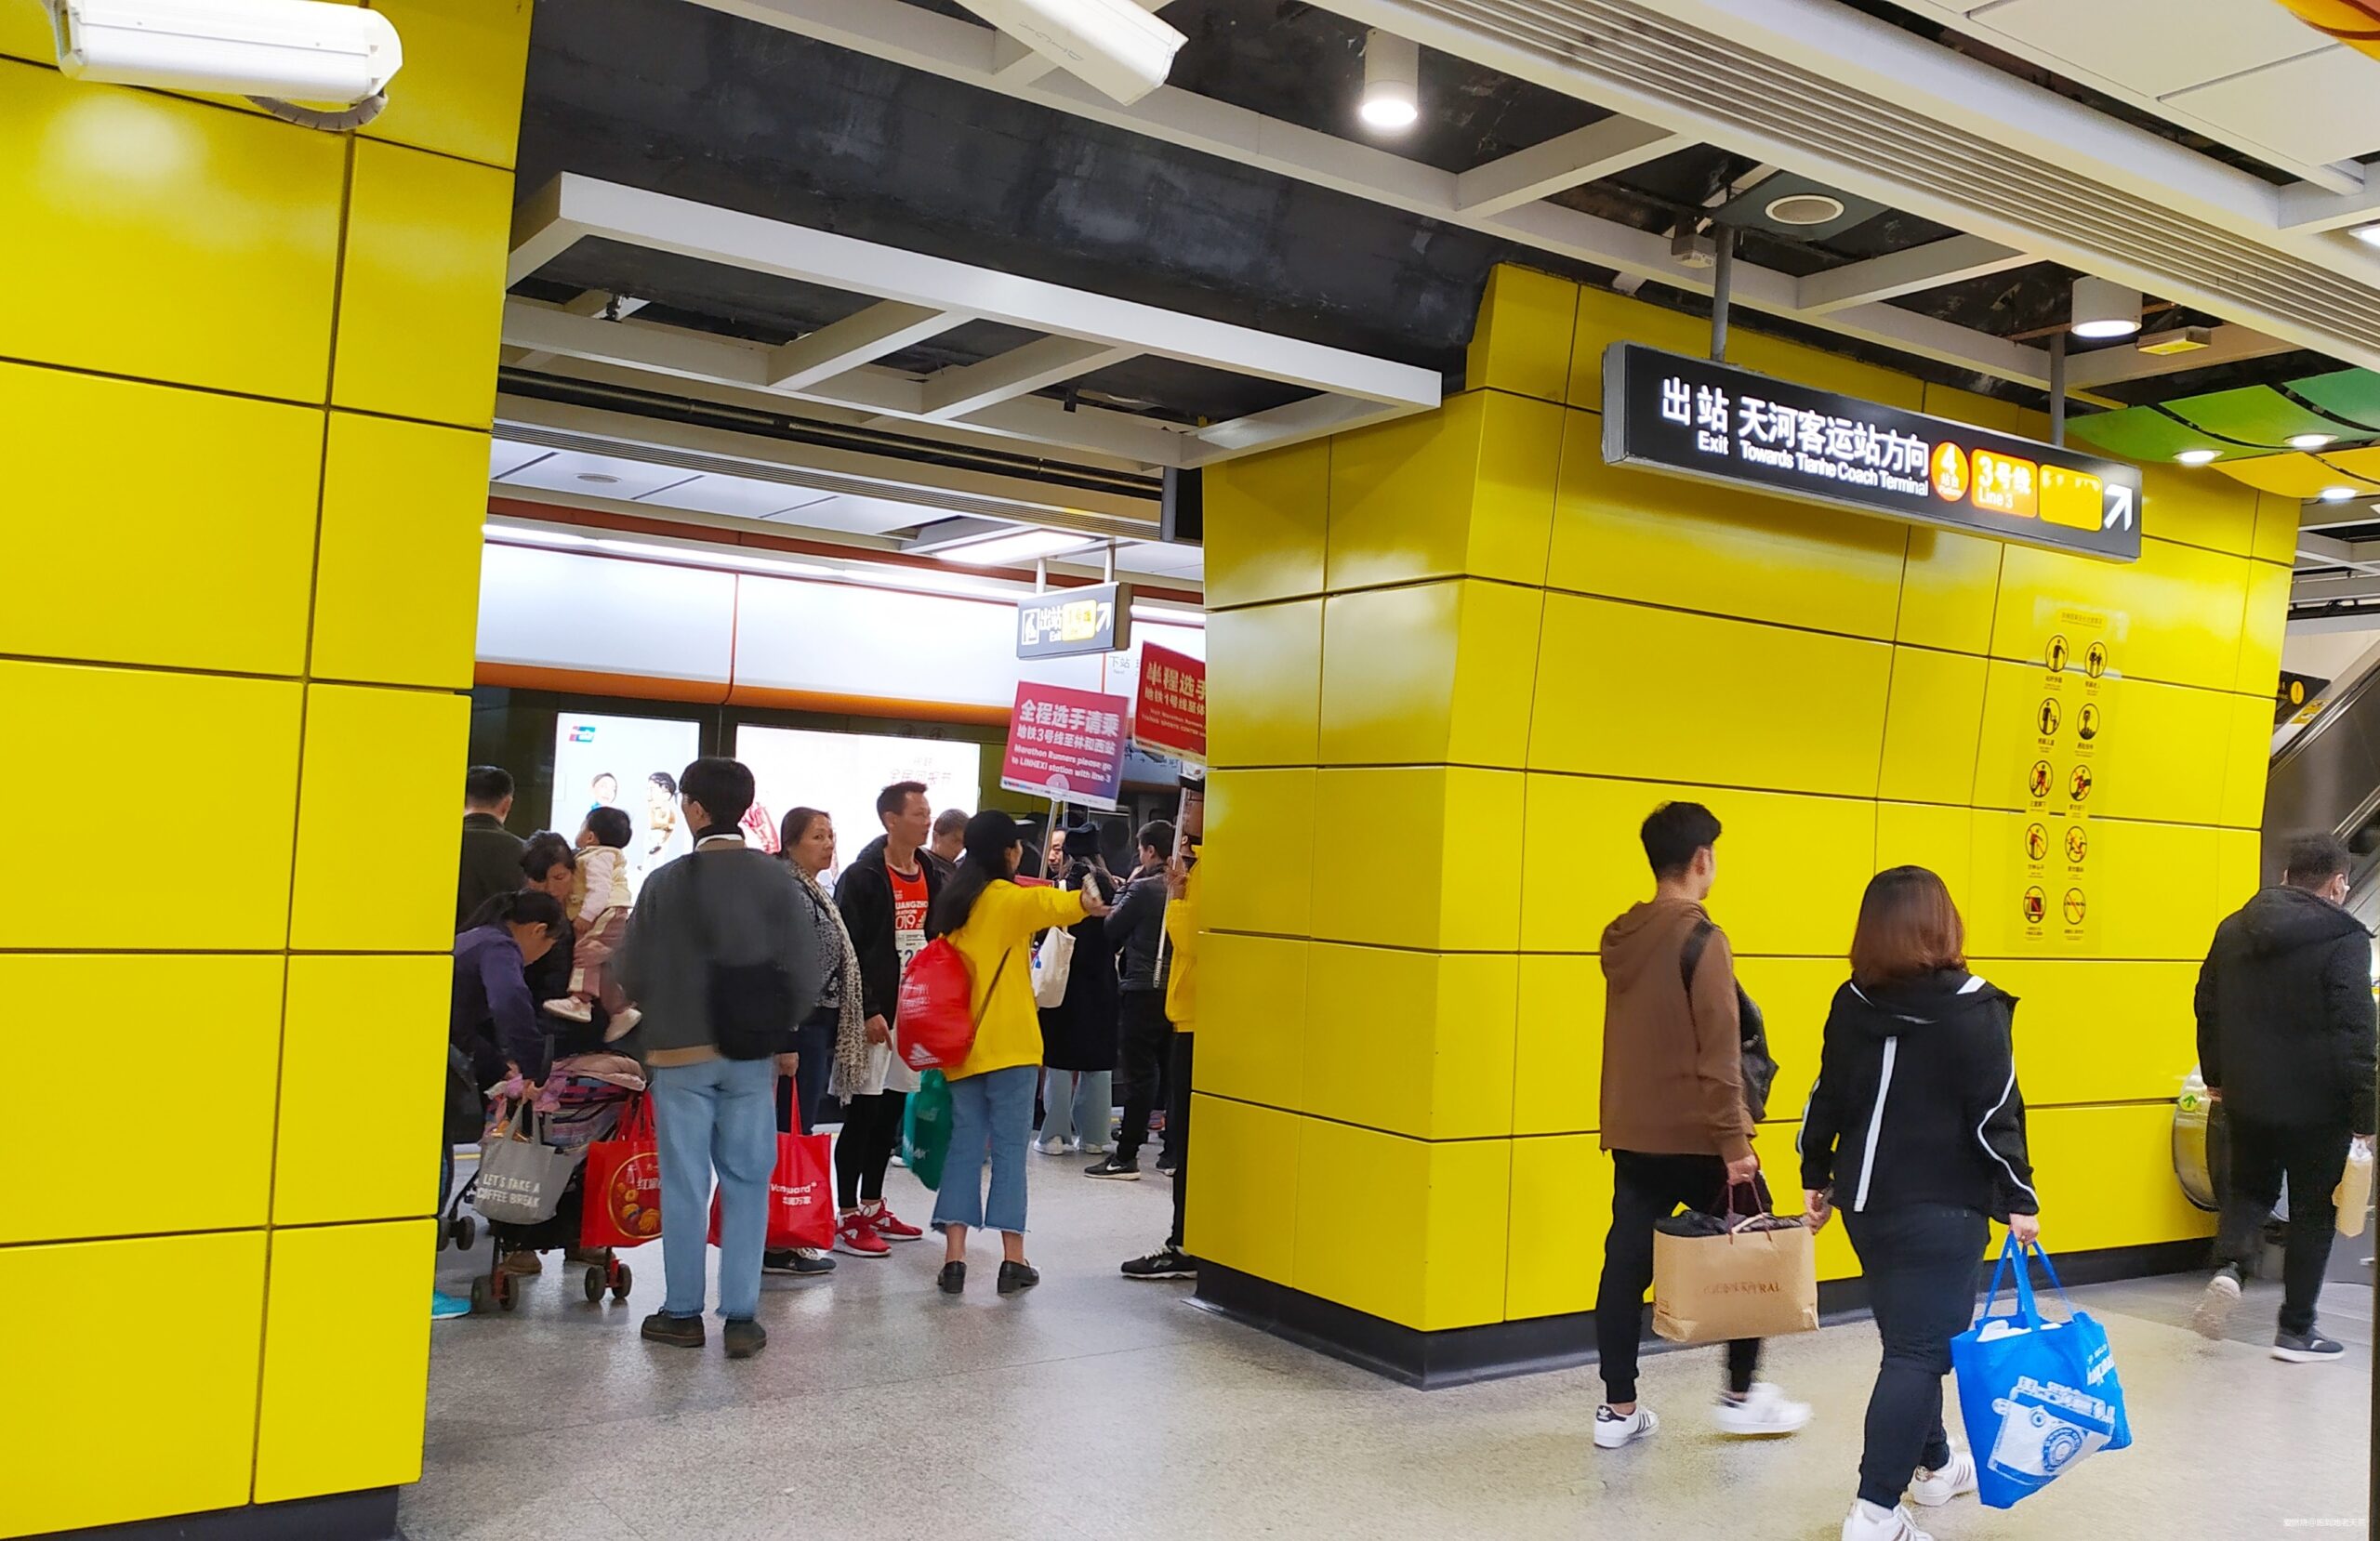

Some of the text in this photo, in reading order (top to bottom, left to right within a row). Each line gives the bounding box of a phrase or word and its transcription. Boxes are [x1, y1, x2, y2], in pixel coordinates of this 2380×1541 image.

[1662, 376, 1929, 477] 出站 天河客运站方向
[1697, 429, 1929, 496] Exit Towards Tianhe Coach Terminal
[1940, 442, 1958, 475] 4
[1977, 454, 2031, 495] 3号线
[1977, 486, 2014, 509] Line 3
[1108, 655, 1130, 668] 下站
[1146, 661, 1206, 701] 半程选手
[1019, 699, 1119, 737] 全程选手请乘
[1016, 723, 1117, 756] 地铁3号线至林和西站
[1011, 756, 1019, 765] to
[1049, 764, 1074, 775] station
[1075, 769, 1091, 779] with
[1013, 744, 1113, 772] Marathon Runners please go
[895, 900, 929, 910] UANGZHO
[895, 915, 916, 929] 019
[477, 1187, 540, 1207] COFFEE BREAK
[508, 1178, 532, 1192] TAKE
[532, 1182, 540, 1193] A
